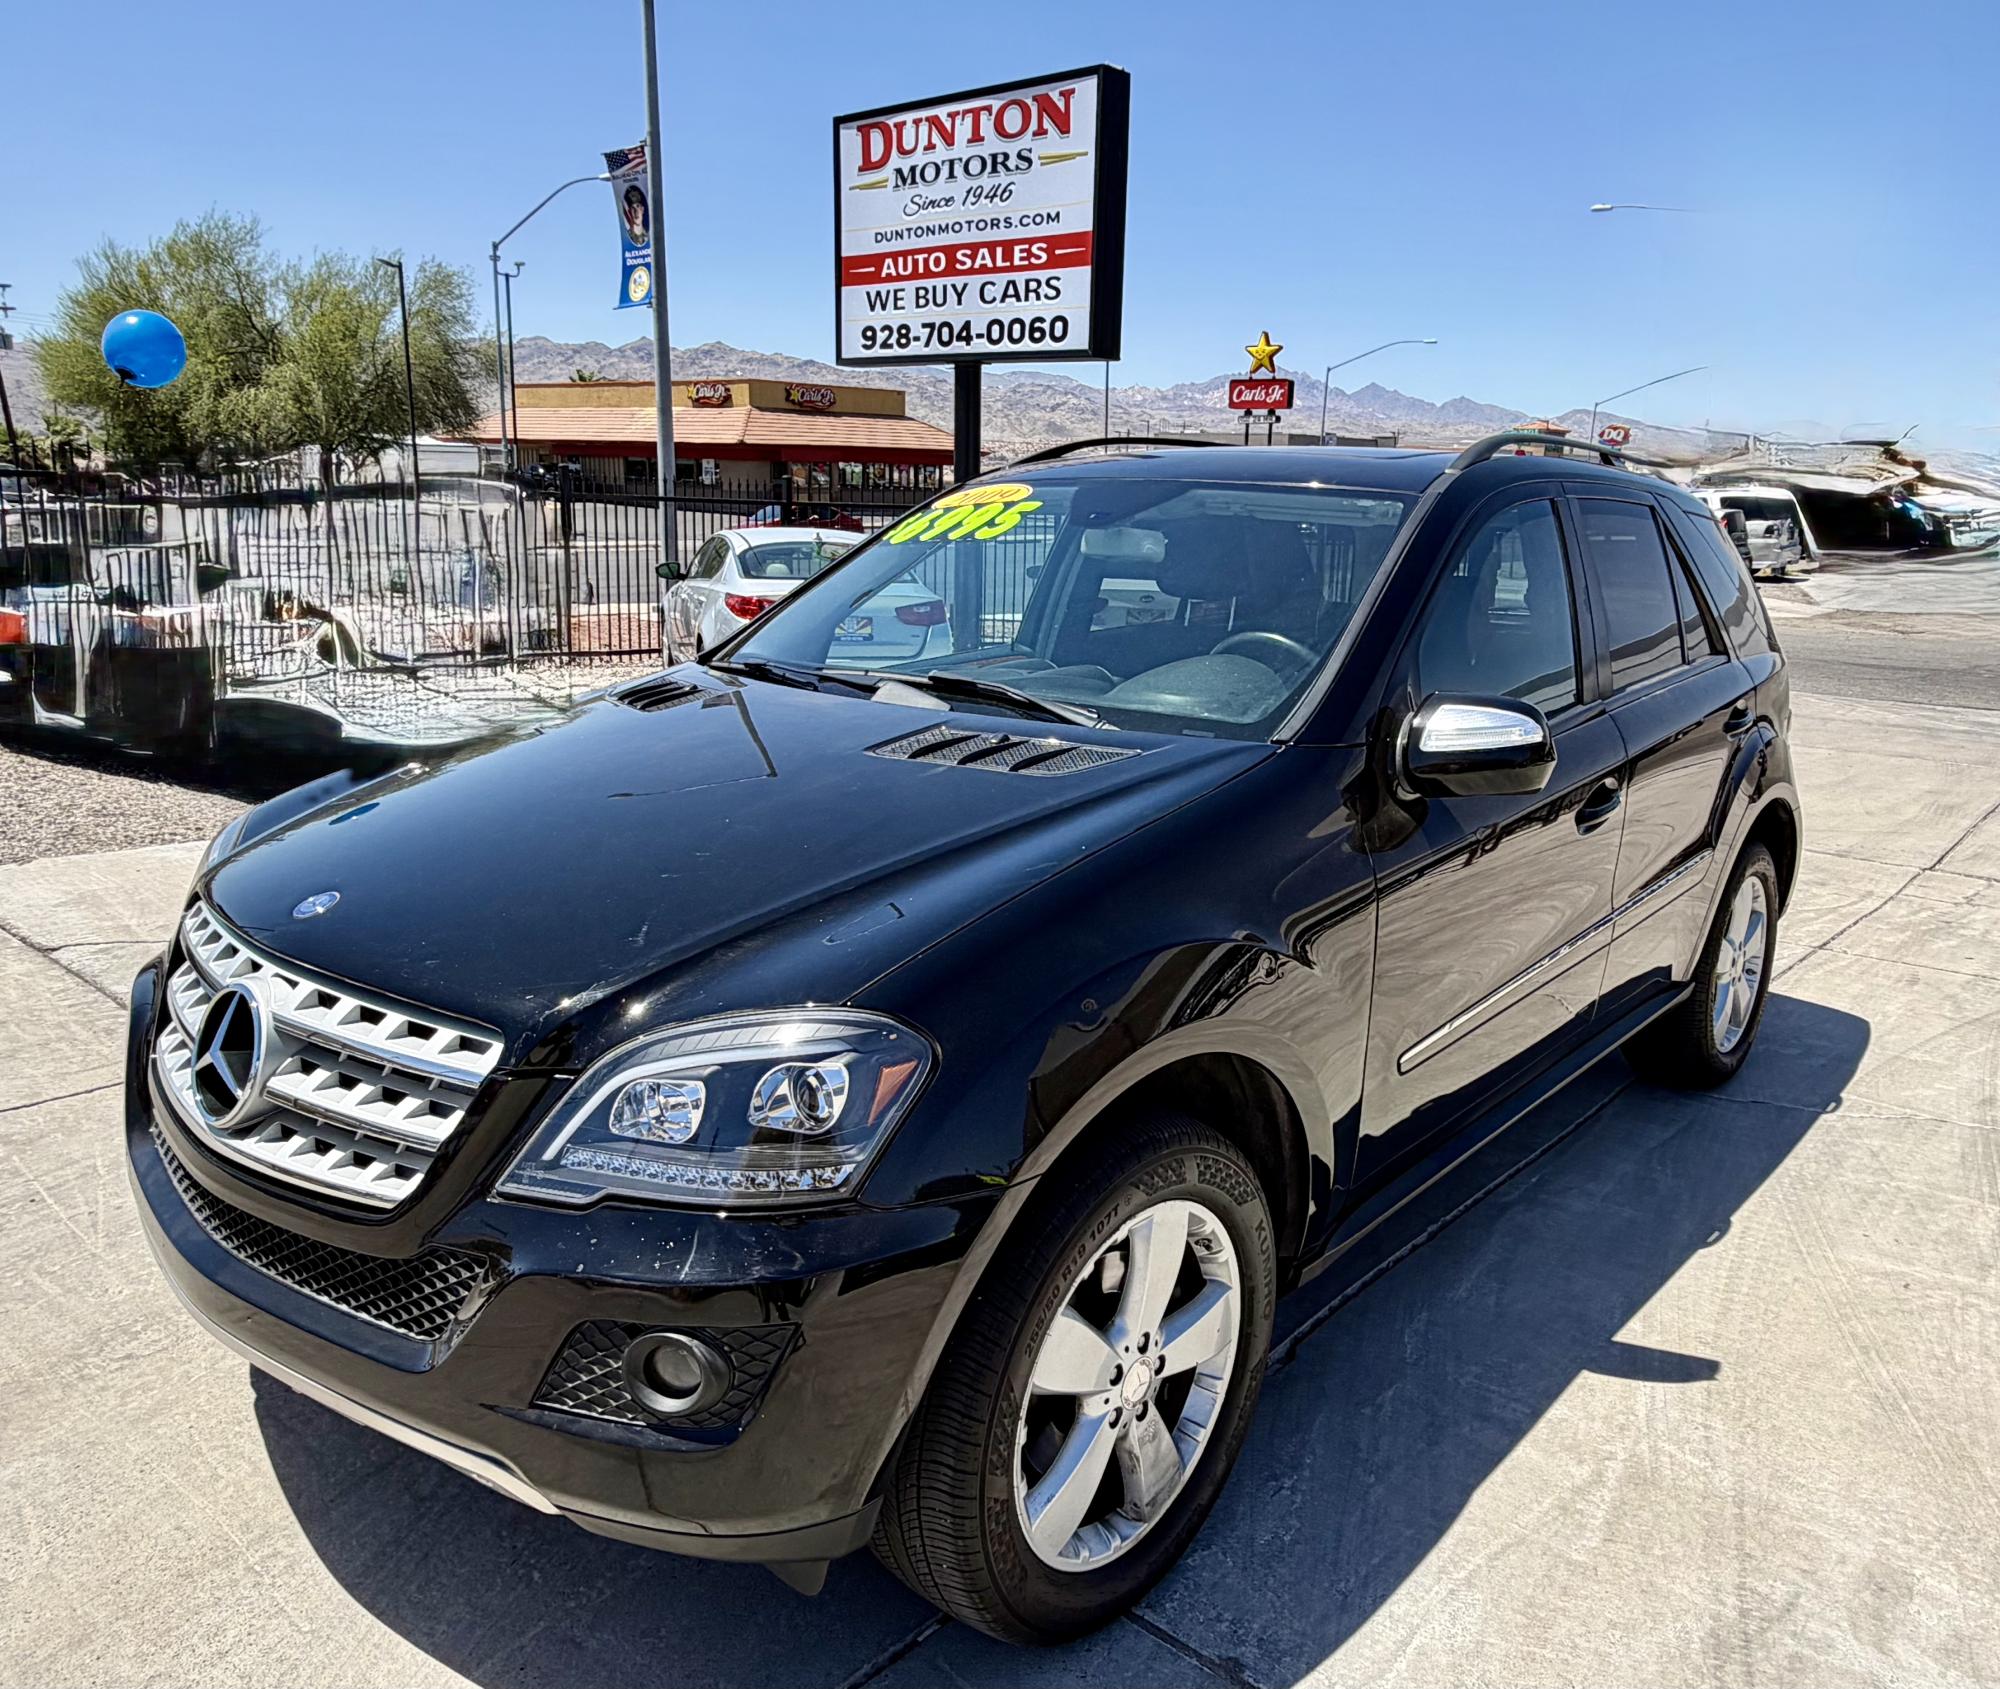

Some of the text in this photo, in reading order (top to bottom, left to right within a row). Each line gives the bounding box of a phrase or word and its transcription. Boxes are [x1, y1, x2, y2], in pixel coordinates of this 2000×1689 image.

[857, 88, 1076, 174] DUNTON
[893, 147, 1034, 190] MOTORS
[902, 181, 1016, 218] Since 1946
[874, 210, 1061, 243] DUNTONMOTORS.COM
[881, 242, 1048, 278] AUTO SALES
[865, 275, 1062, 313] WE BUY CARS
[860, 315, 1070, 351] 928-704-0060
[1232, 384, 1266, 403] Carl's
[1602, 428, 1625, 442] DQ
[1255, 1218, 1273, 1321] KUMHO
